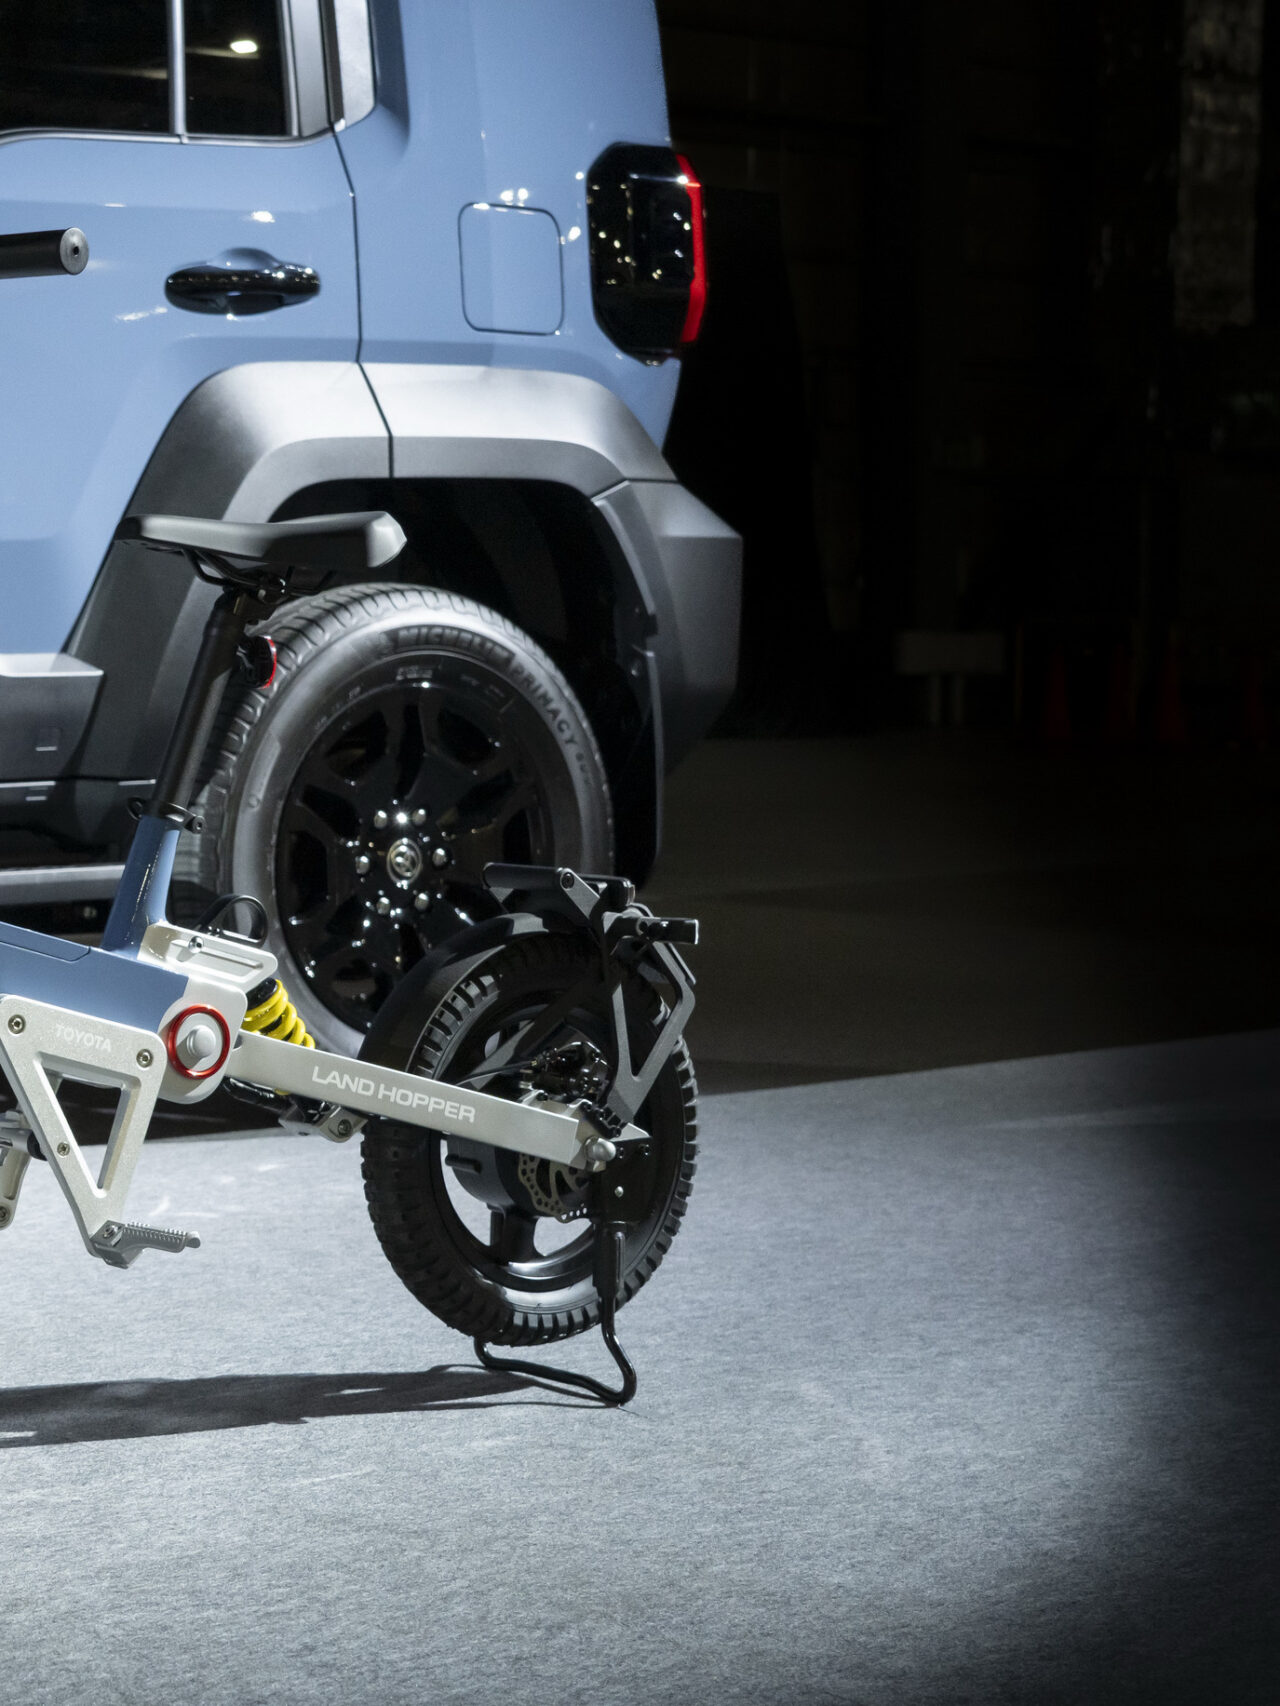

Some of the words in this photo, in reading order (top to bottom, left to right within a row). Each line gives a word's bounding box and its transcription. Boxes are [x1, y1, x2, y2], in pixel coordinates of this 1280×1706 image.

[508, 664, 578, 746] PRIMACY
[55, 1022, 112, 1053] TOYOTA
[311, 1065, 375, 1097] LAND
[377, 1083, 476, 1123] HOPPER
